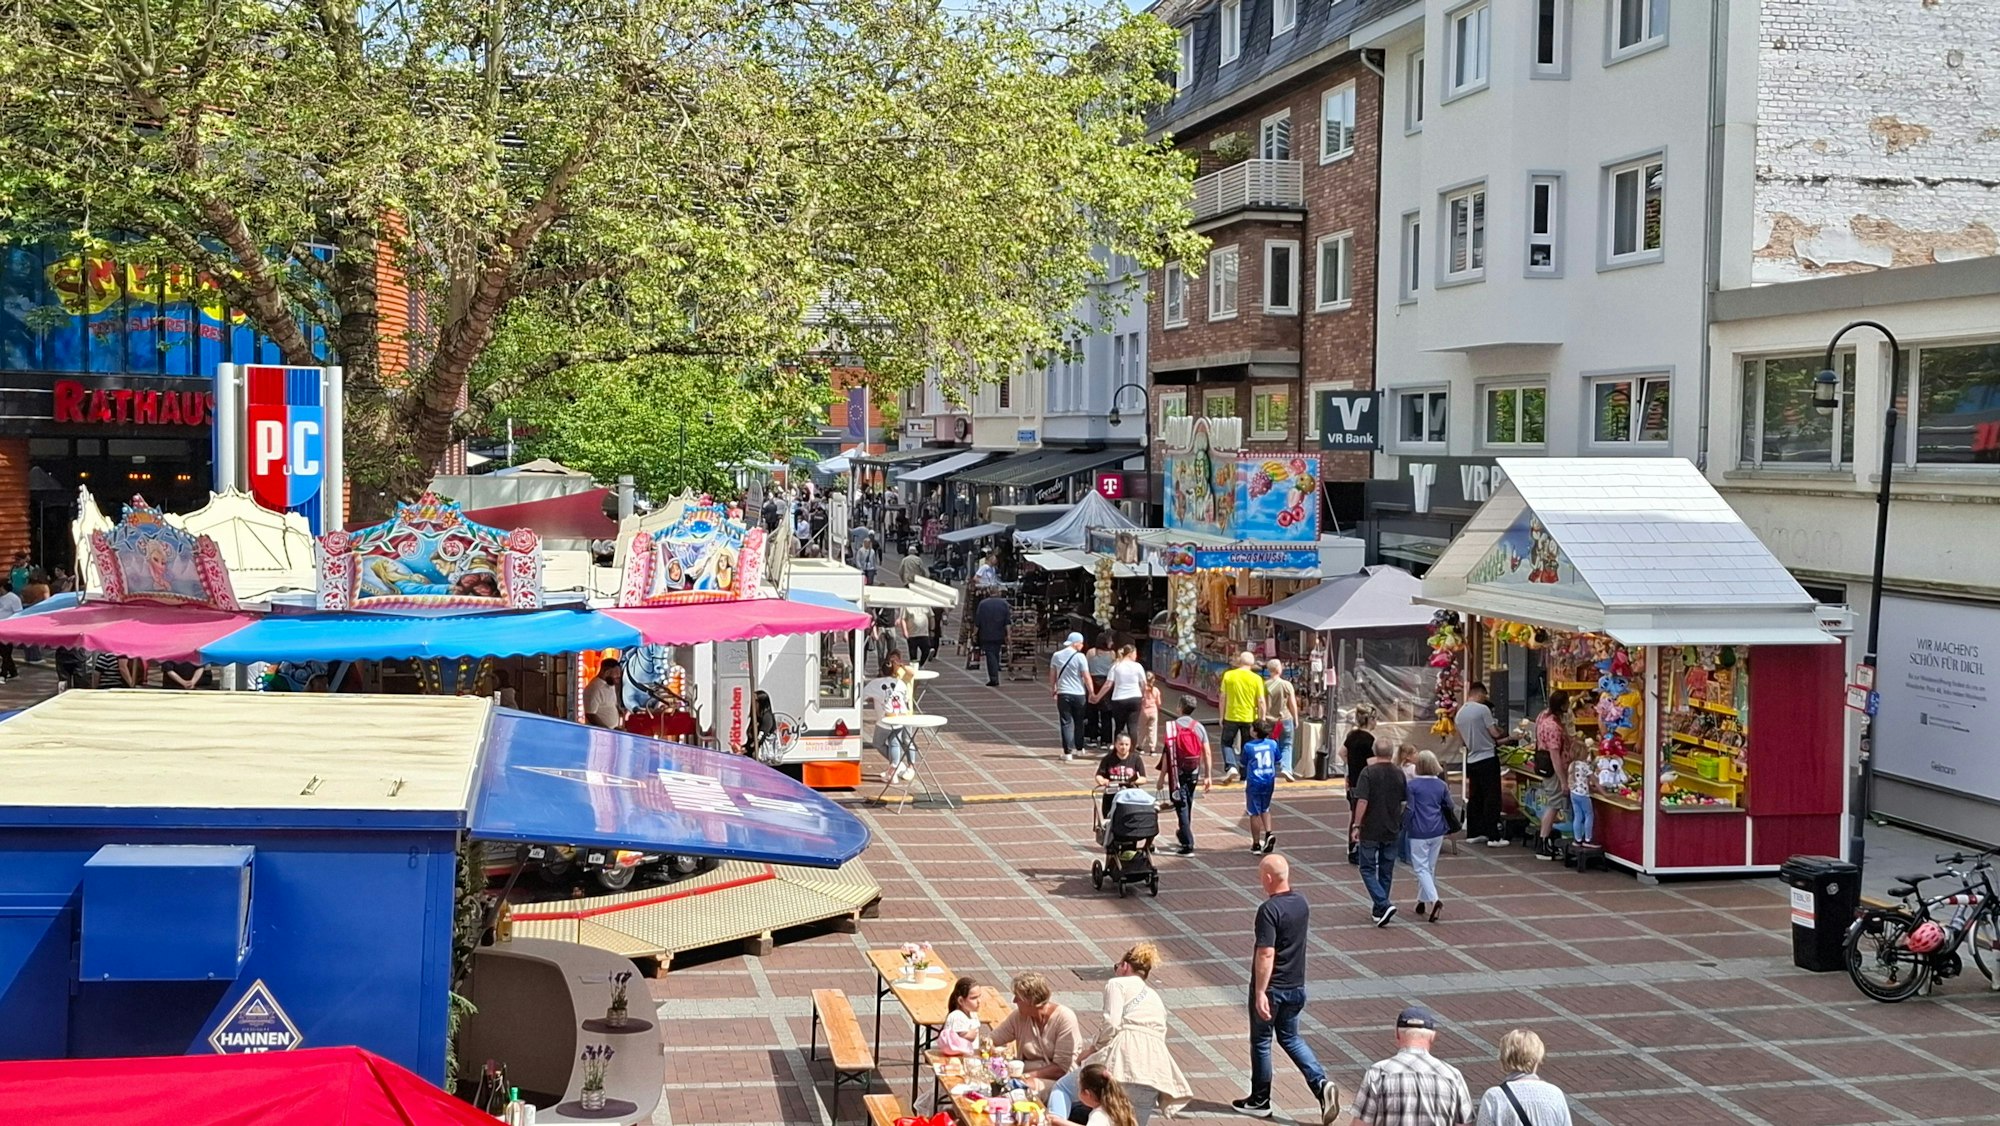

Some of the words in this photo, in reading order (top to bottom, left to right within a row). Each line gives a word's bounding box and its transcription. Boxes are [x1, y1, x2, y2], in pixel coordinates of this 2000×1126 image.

[1327, 433, 1343, 443] VR
[1346, 433, 1374, 444] Bank
[1103, 478, 1117, 494] T
[1460, 464, 1488, 501] VR
[1916, 638, 1932, 651] WIR
[1933, 640, 1979, 658] MACHEN'S
[1909, 652, 1940, 668] SCHÖN
[1941, 655, 1959, 672] FÜR
[729, 687, 742, 744] lätzchen
[781, 716, 808, 742] ny's
[1254, 750, 1272, 769] 14
[220, 1031, 290, 1046] HANNEN
